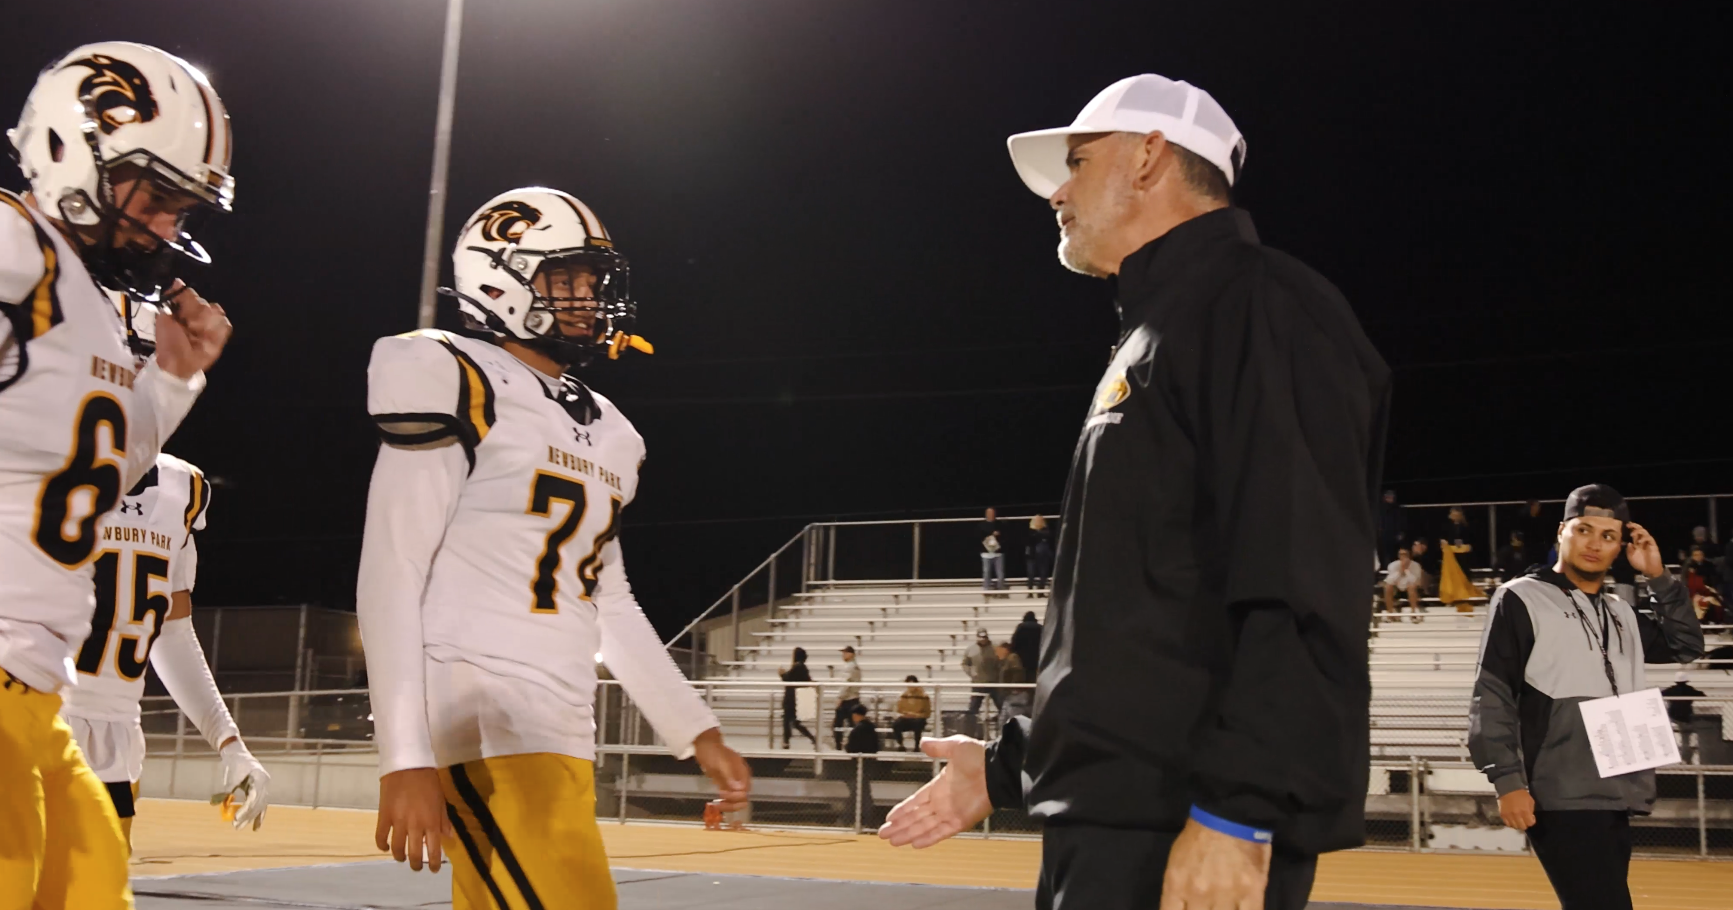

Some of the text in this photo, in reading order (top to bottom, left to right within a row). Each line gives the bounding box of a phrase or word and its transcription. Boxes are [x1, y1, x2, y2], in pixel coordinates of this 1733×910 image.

[32, 392, 127, 569] 6
[548, 445, 622, 491] NEWBURY PARK
[103, 526, 172, 551] WBURY PARK
[76, 549, 171, 682] 15
